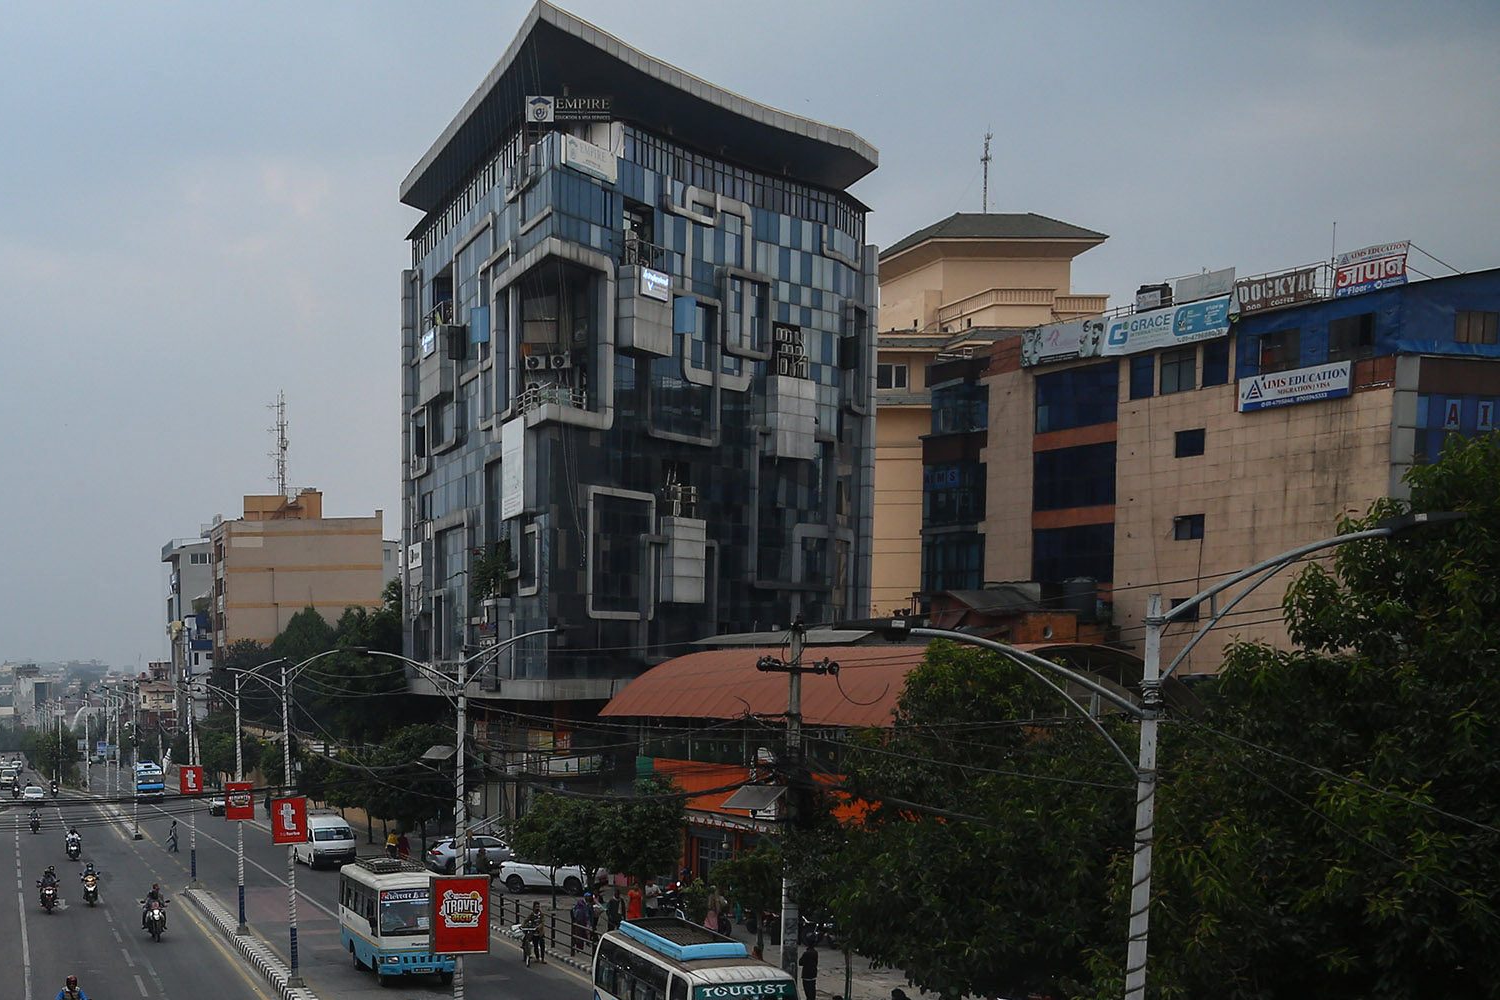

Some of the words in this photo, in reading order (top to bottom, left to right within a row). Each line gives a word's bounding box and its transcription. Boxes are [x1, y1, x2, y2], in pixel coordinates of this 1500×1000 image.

[556, 98, 610, 109] EMPIRE
[579, 144, 605, 160] EMPIRE
[1131, 314, 1171, 331] GRACE
[1262, 379, 1286, 390] AIMS
[1288, 368, 1348, 386] EDUCATION
[445, 899, 479, 914] TRAVEL
[702, 984, 787, 998] TOURIST
